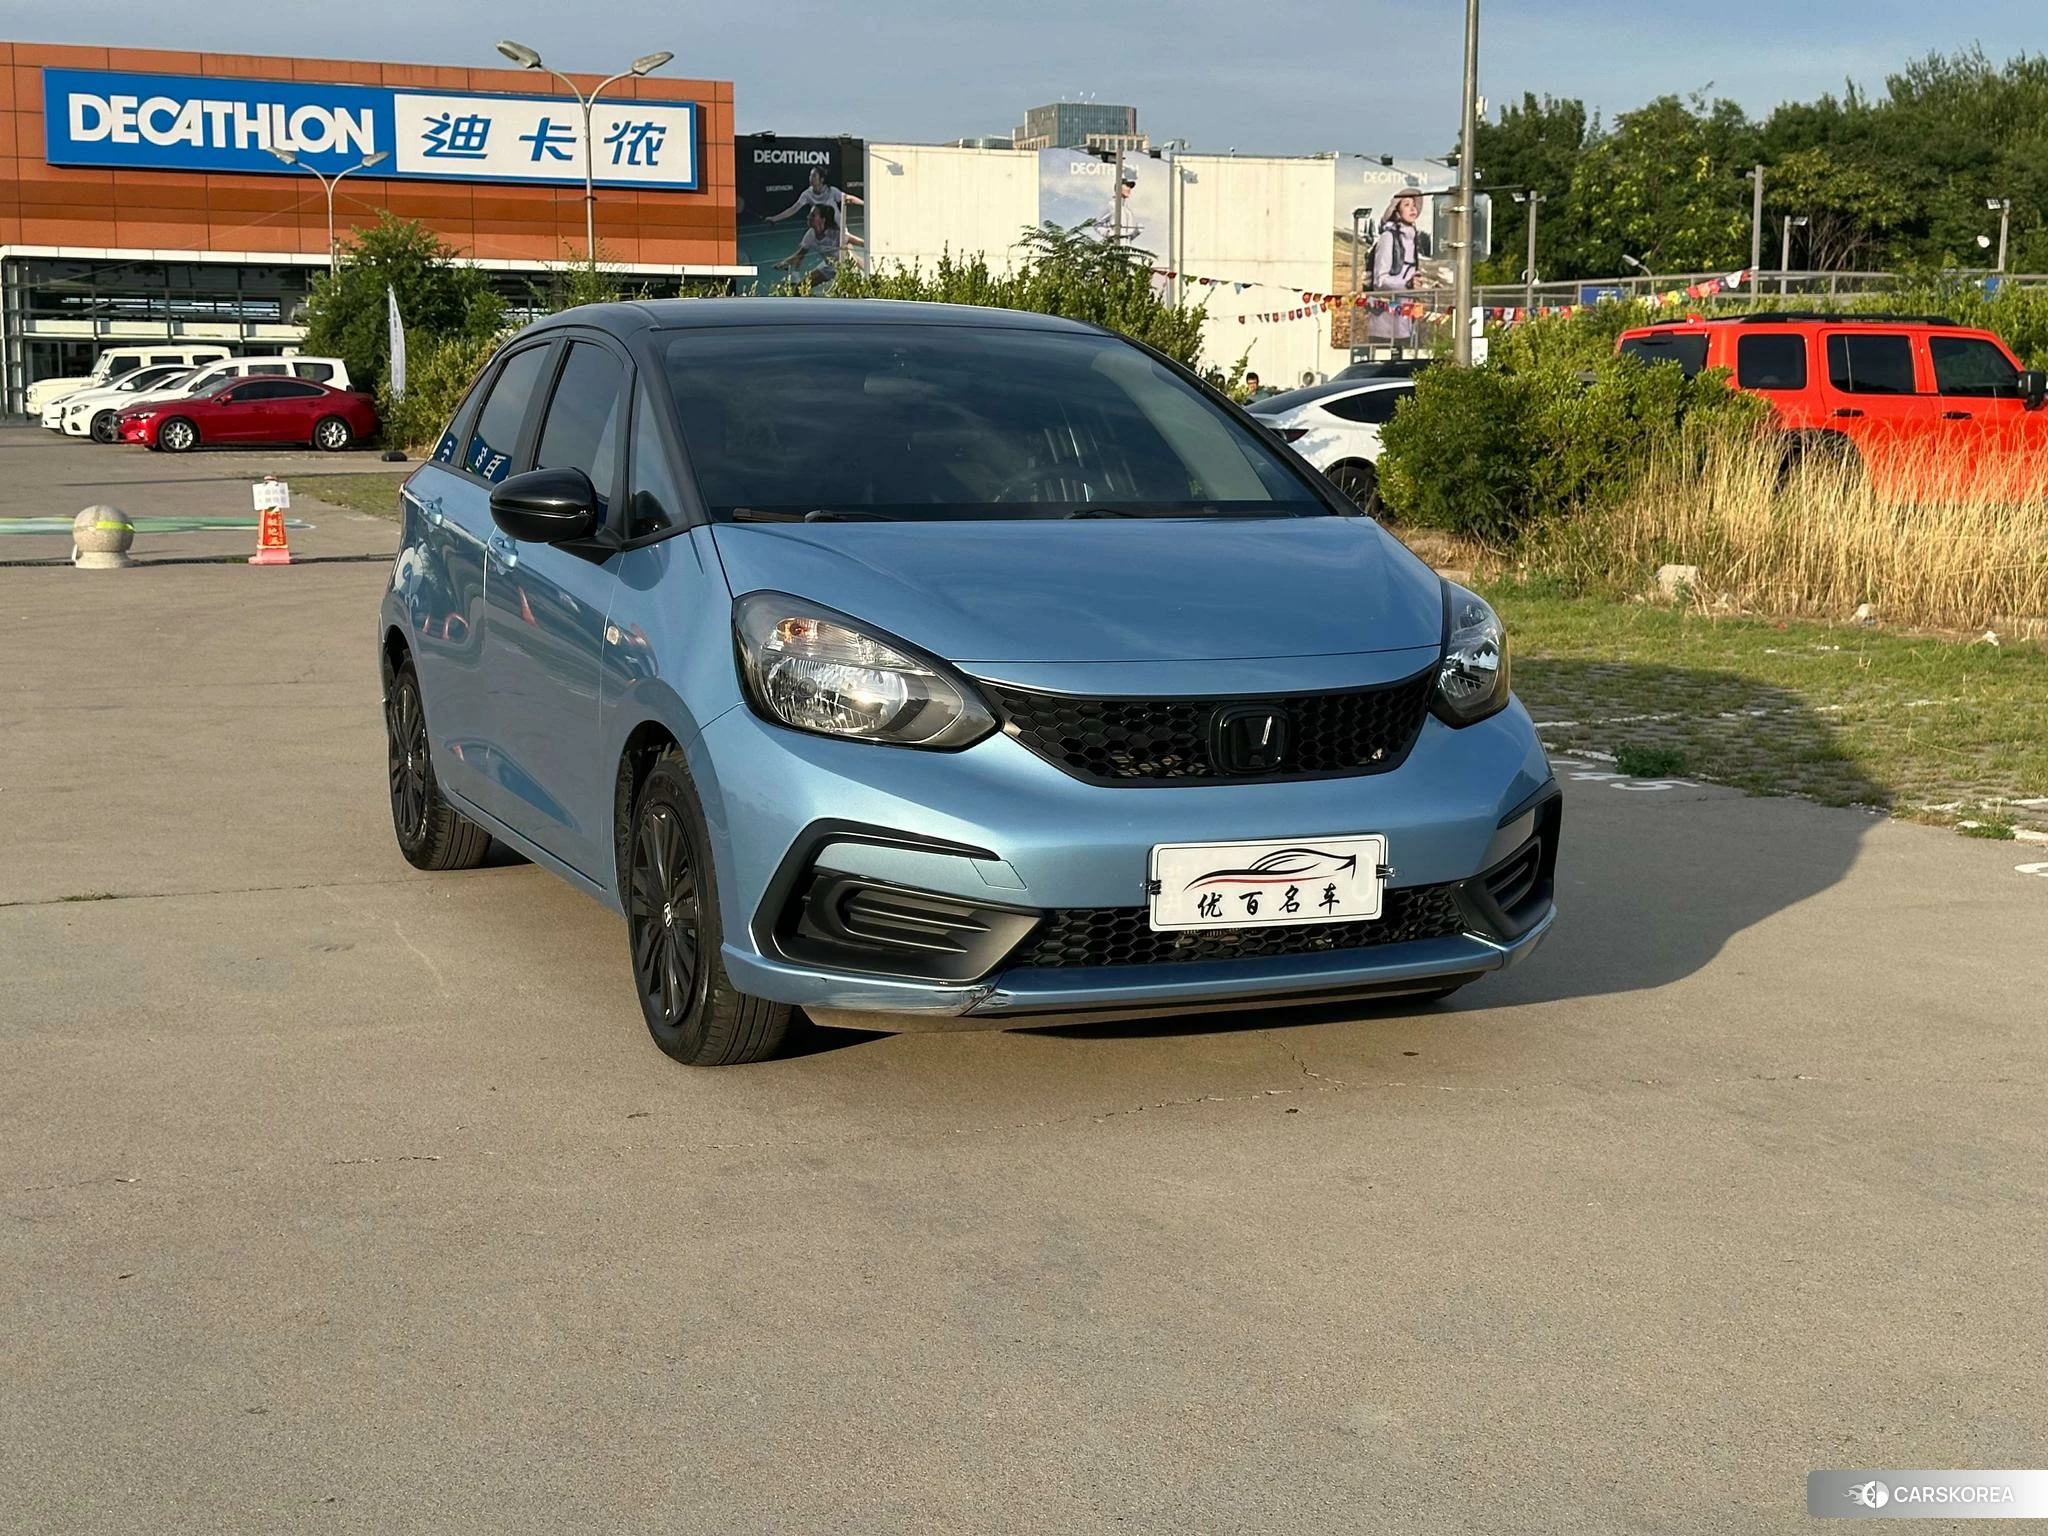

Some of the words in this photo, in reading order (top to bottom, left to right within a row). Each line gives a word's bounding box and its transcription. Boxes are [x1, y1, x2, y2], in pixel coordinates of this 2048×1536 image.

[68, 93, 375, 155] DECATHLON
[421, 112, 667, 166] 迪卡侬
[753, 149, 831, 165] DECATHLON
[1070, 161, 1140, 177] DECATHN
[1363, 170, 1429, 185] DECATHN
[1197, 882, 1340, 918] 优百名车
